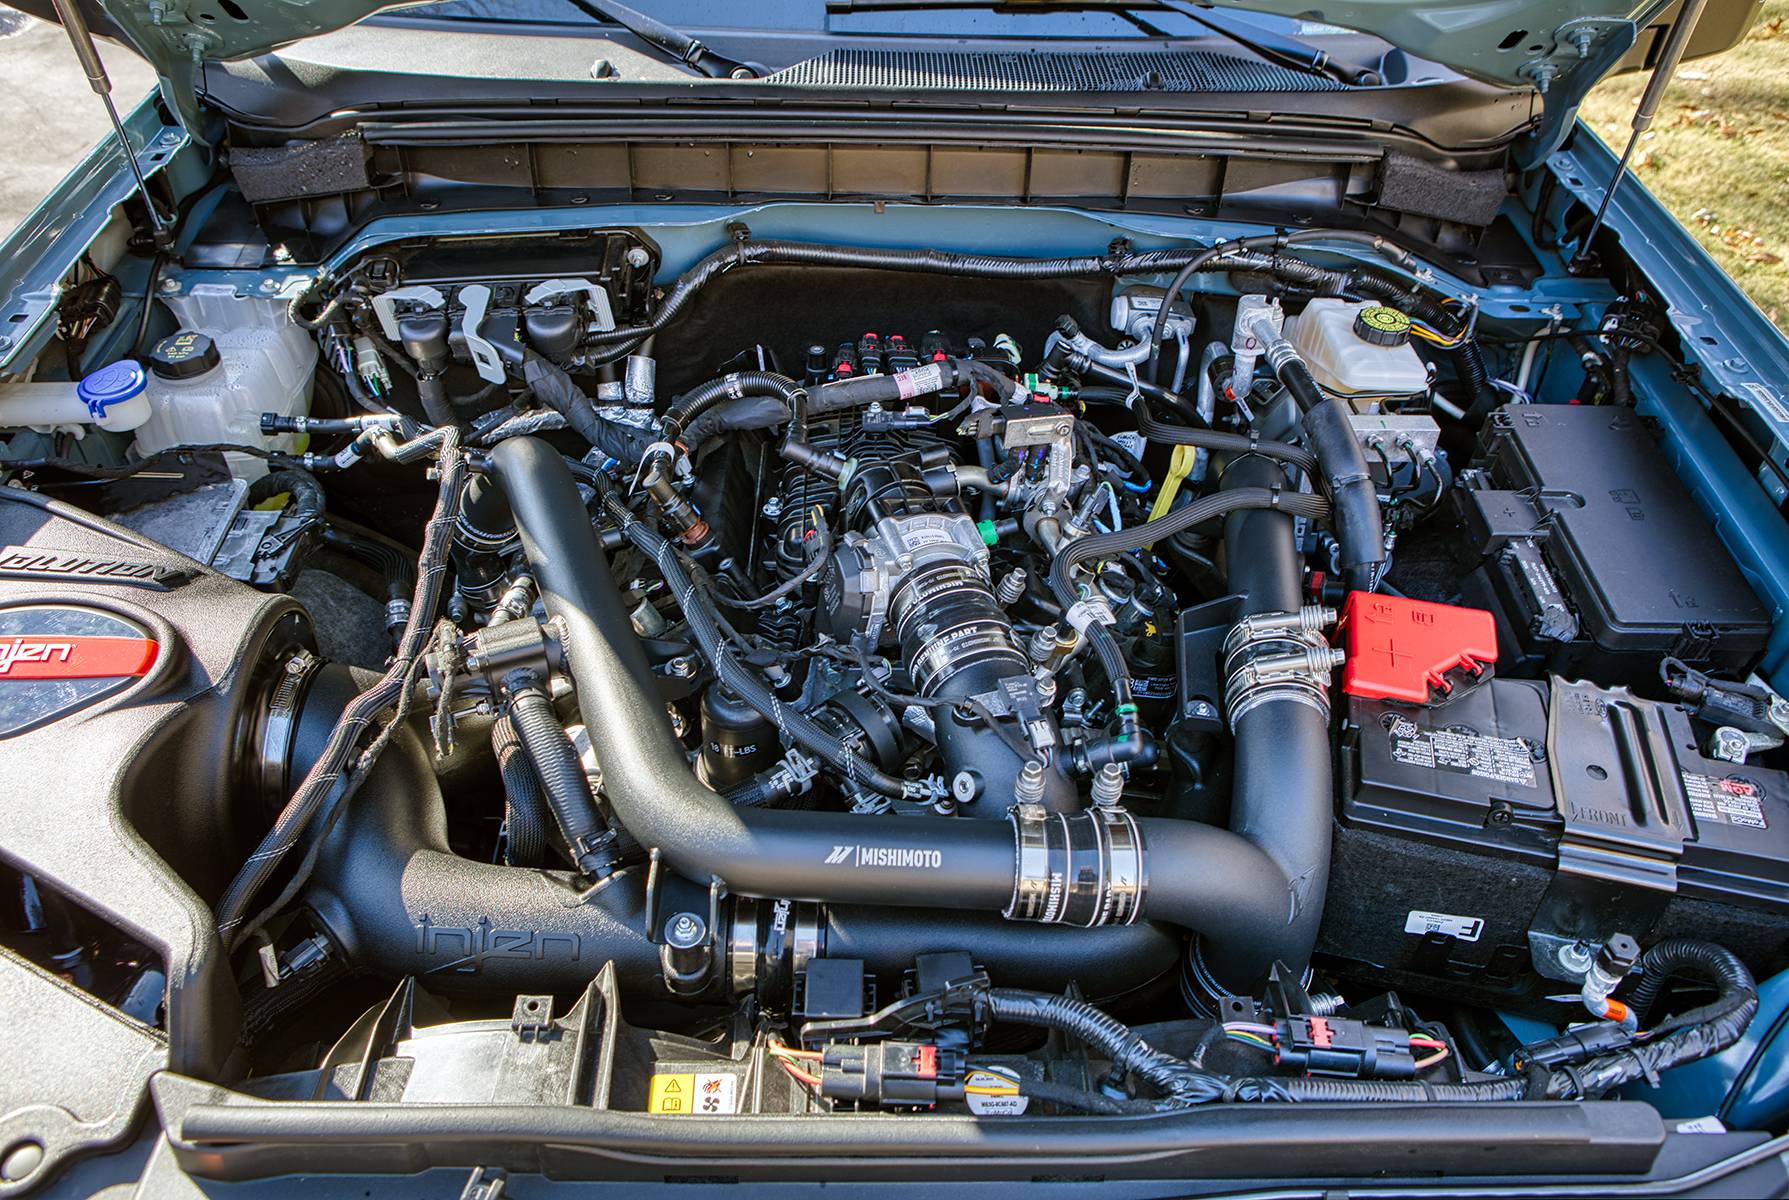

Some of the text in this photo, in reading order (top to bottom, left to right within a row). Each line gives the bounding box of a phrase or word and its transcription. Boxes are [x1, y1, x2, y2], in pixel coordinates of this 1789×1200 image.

[950, 626, 978, 641] PART
[1580, 806, 1627, 827] FRONT
[861, 847, 942, 868] MISHIMOTO
[1042, 872, 1063, 922] MISHIMOT
[1459, 920, 1481, 938] F
